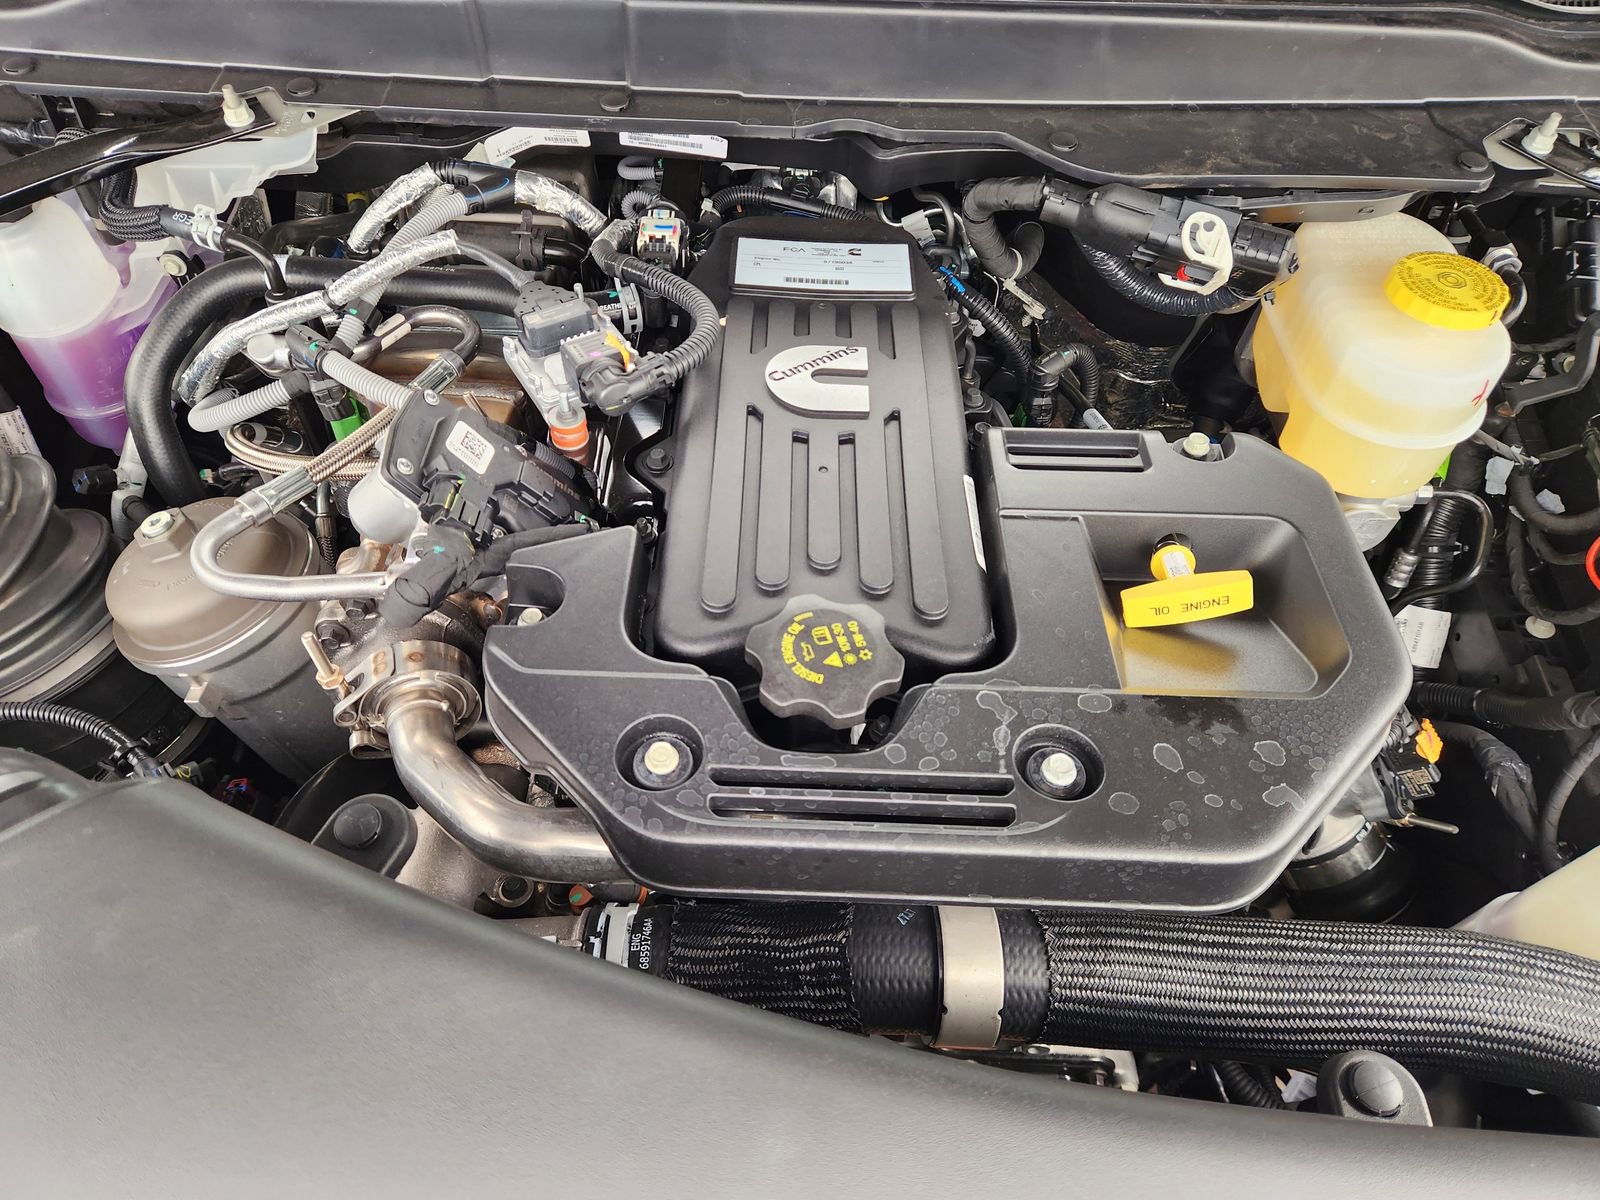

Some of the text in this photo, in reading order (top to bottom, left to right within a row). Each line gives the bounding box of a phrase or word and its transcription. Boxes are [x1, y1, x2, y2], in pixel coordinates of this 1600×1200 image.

[768, 346, 859, 381] Cummins
[1149, 595, 1230, 616] ENGINE OIL
[781, 622, 824, 685] DIESEL ENGINE OIL
[631, 933, 642, 952] ENG
